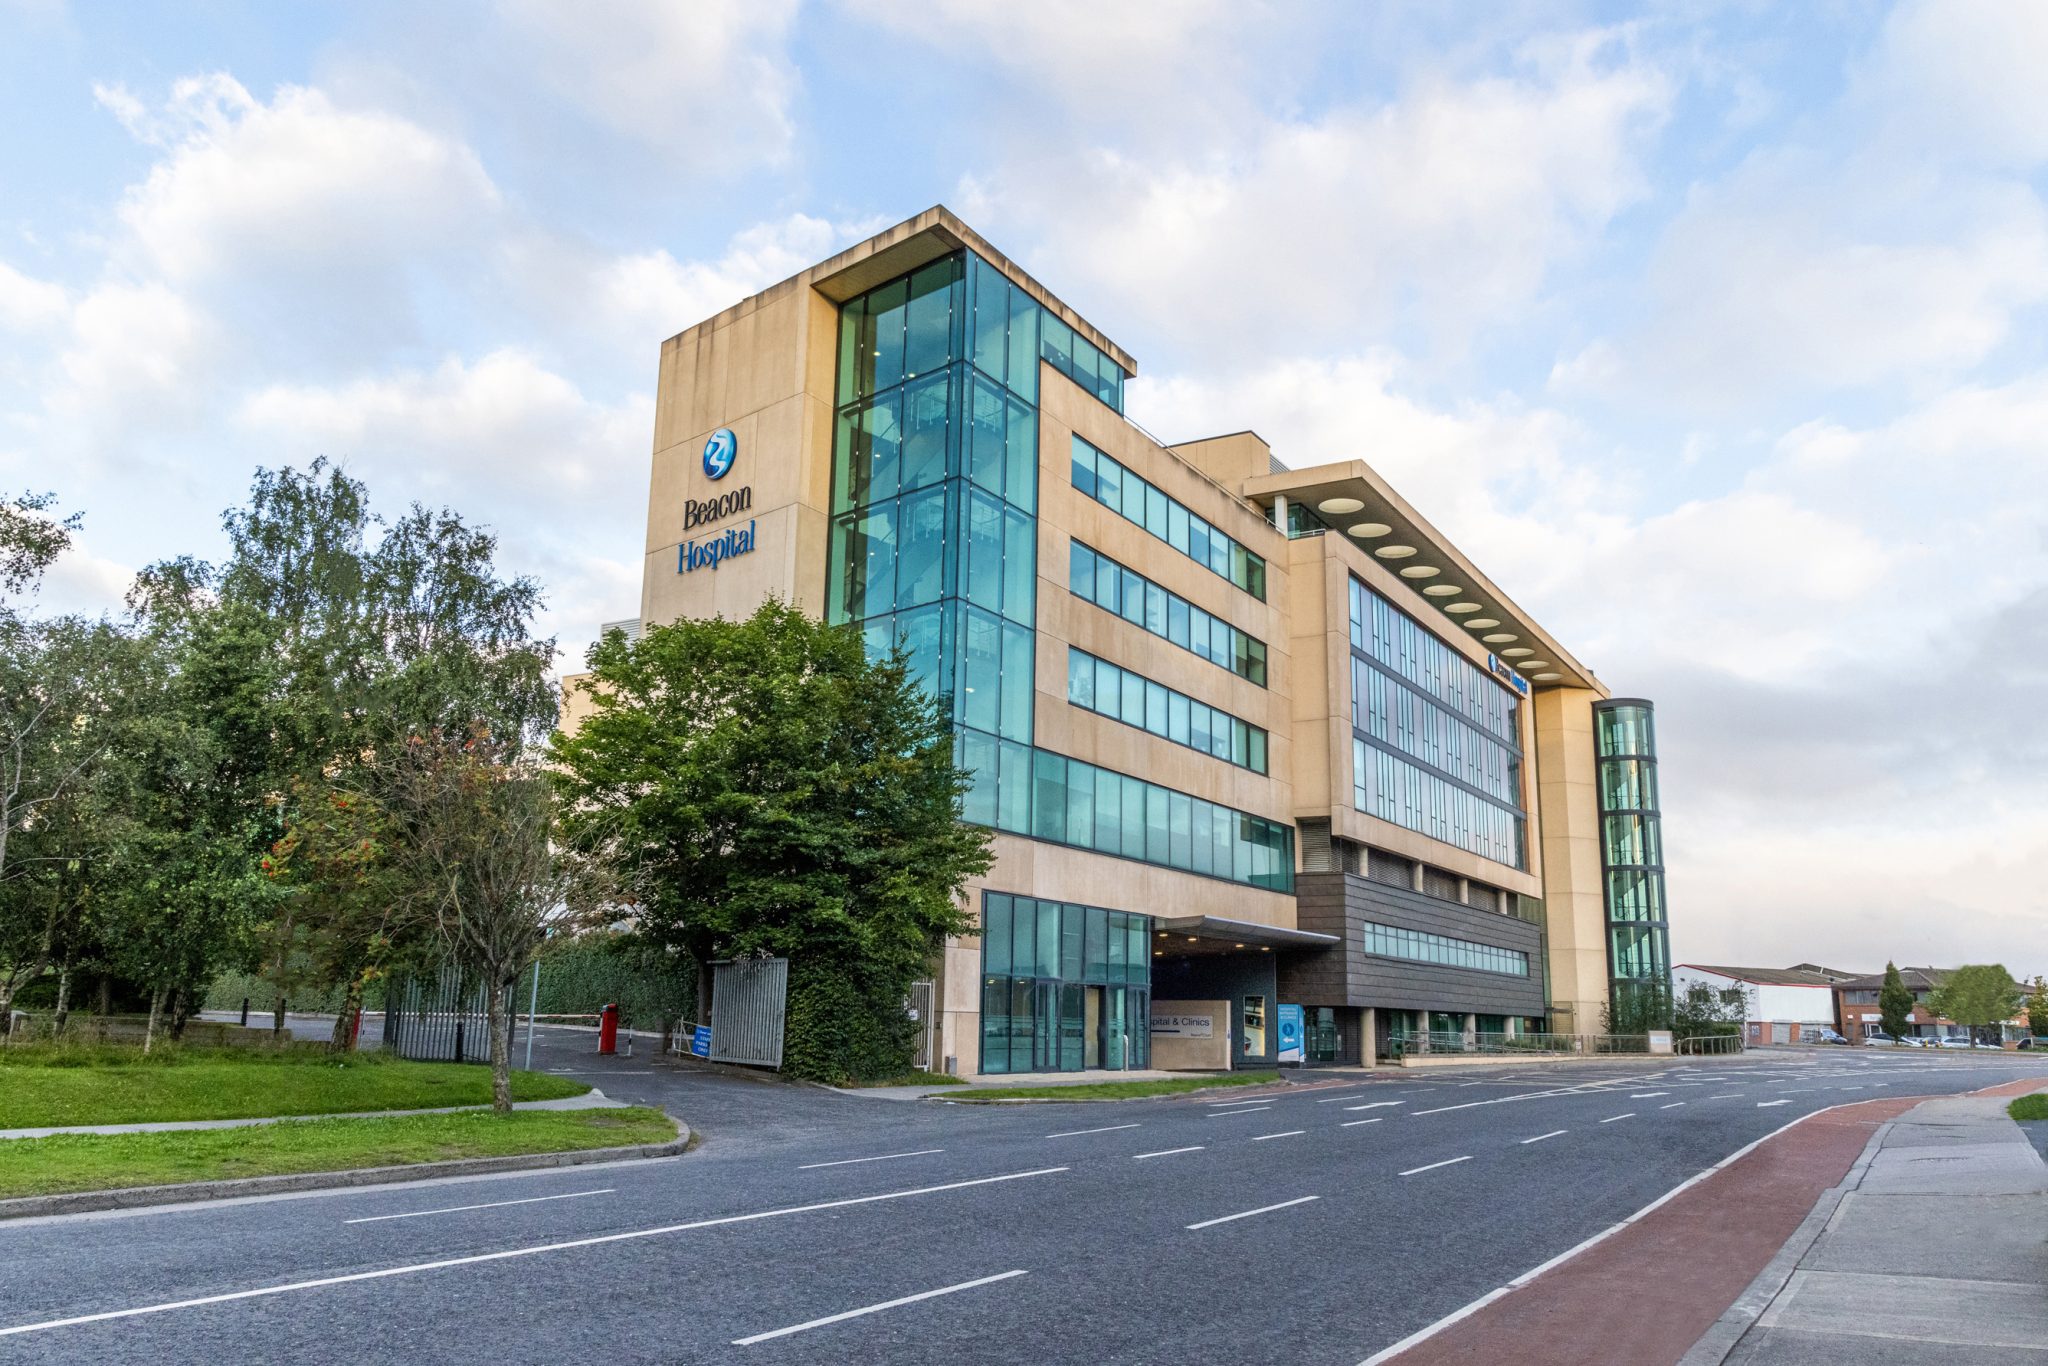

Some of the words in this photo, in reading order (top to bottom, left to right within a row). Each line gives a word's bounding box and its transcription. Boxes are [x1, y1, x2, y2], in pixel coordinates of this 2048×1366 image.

[683, 486, 752, 530] Beacon
[677, 519, 756, 574] Hospital
[1151, 1017, 1170, 1028] pital
[1172, 1017, 1179, 1026] &
[1181, 1017, 1210, 1027] Clinics
